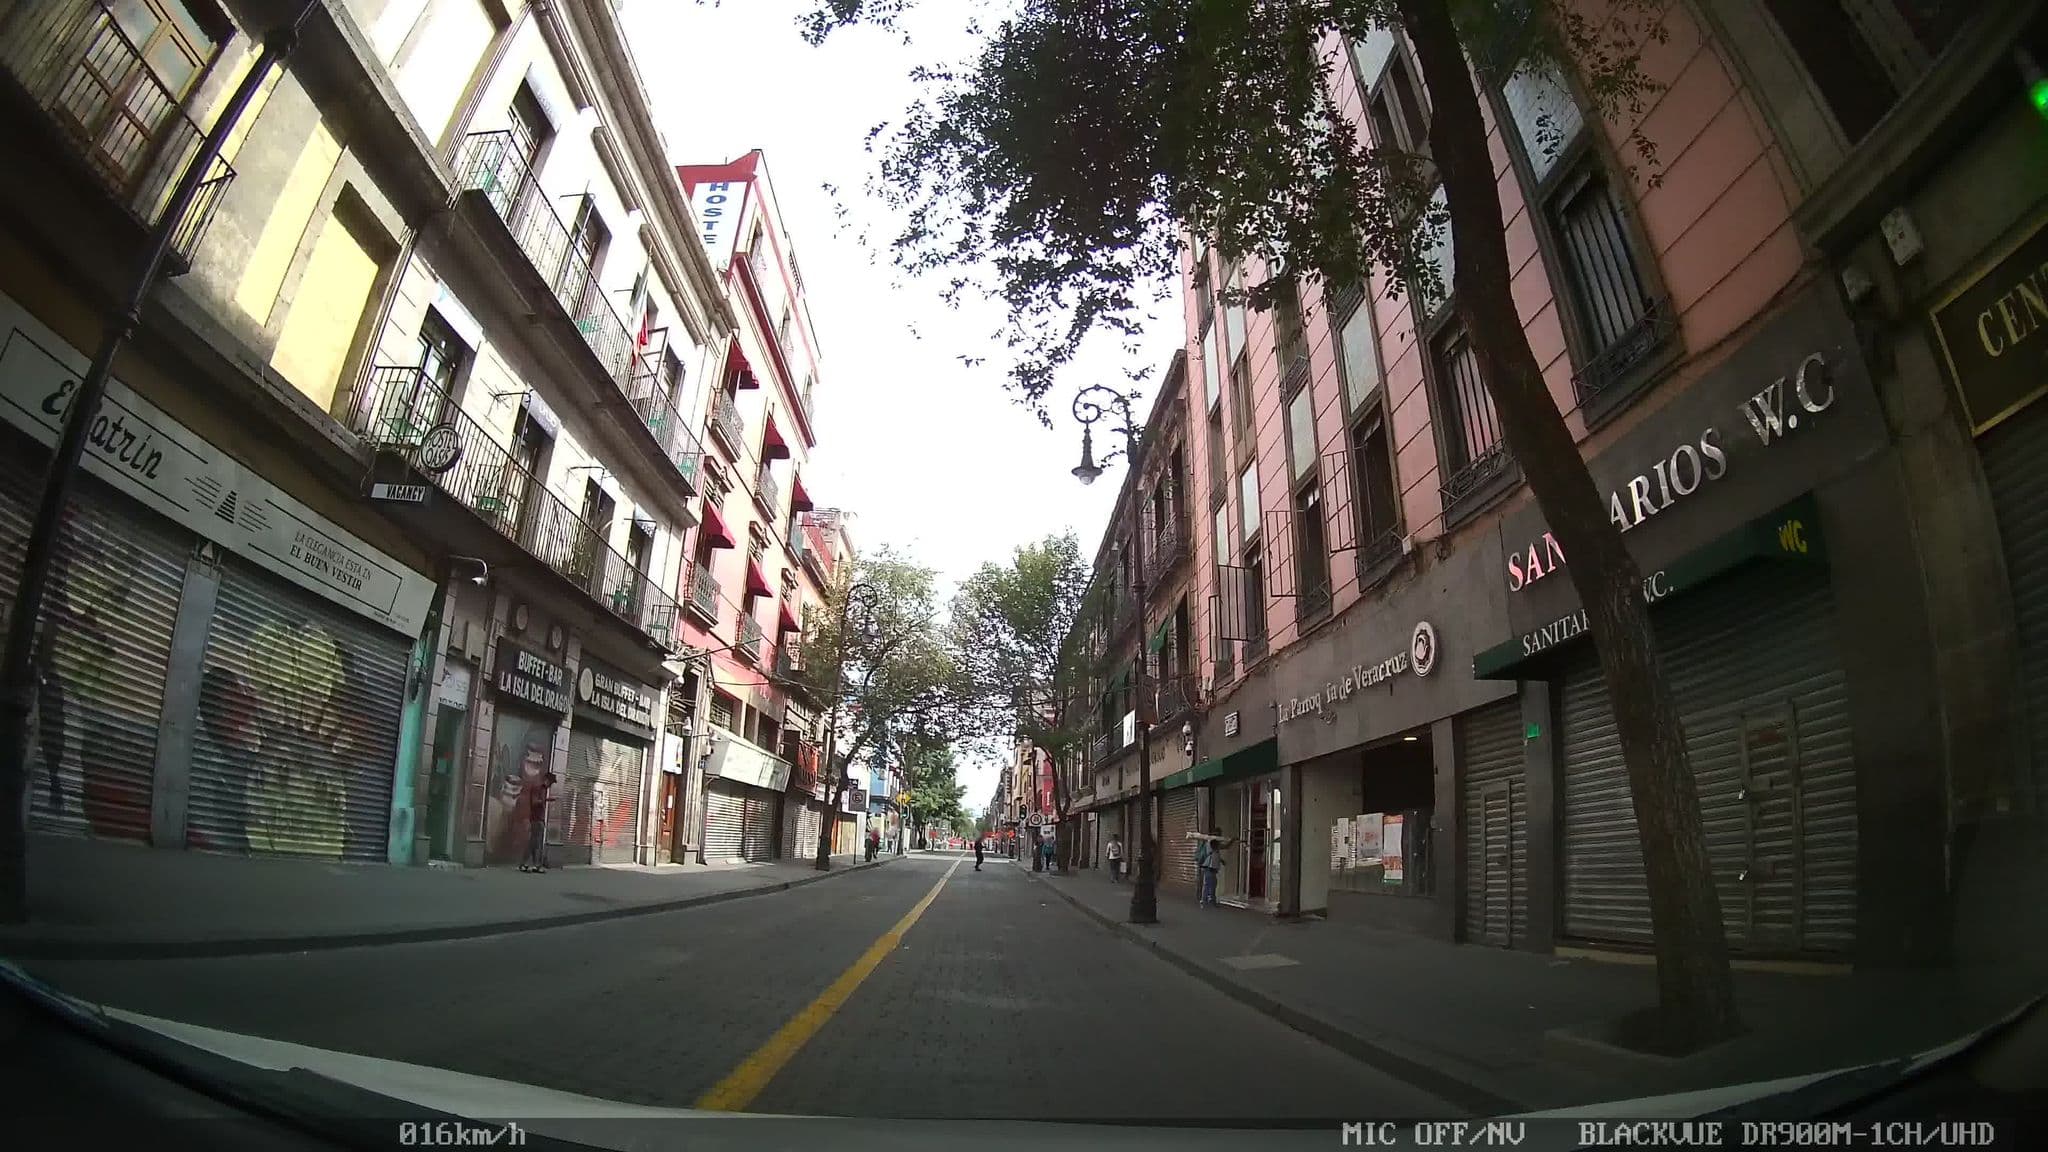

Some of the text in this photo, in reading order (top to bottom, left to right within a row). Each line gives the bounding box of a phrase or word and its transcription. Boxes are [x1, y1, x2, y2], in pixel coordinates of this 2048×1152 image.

[1978, 262, 2048, 357] CEN
[386, 484, 425, 500] VACANCY
[1508, 427, 1728, 592] SANARIOS
[1778, 520, 1807, 553] WC
[290, 543, 363, 591] EL BUEN VESTIR
[500, 671, 511, 693] LA
[512, 676, 530, 700] ISLA
[531, 683, 544, 707] DEL
[595, 673, 613, 693] GRAN
[1279, 704, 1289, 724] La
[1339, 676, 1351, 701] de
[1352, 651, 1408, 690] Veracruz
[591, 690, 601, 708] LA
[601, 695, 615, 713] ISLA
[616, 700, 627, 719] DEL
